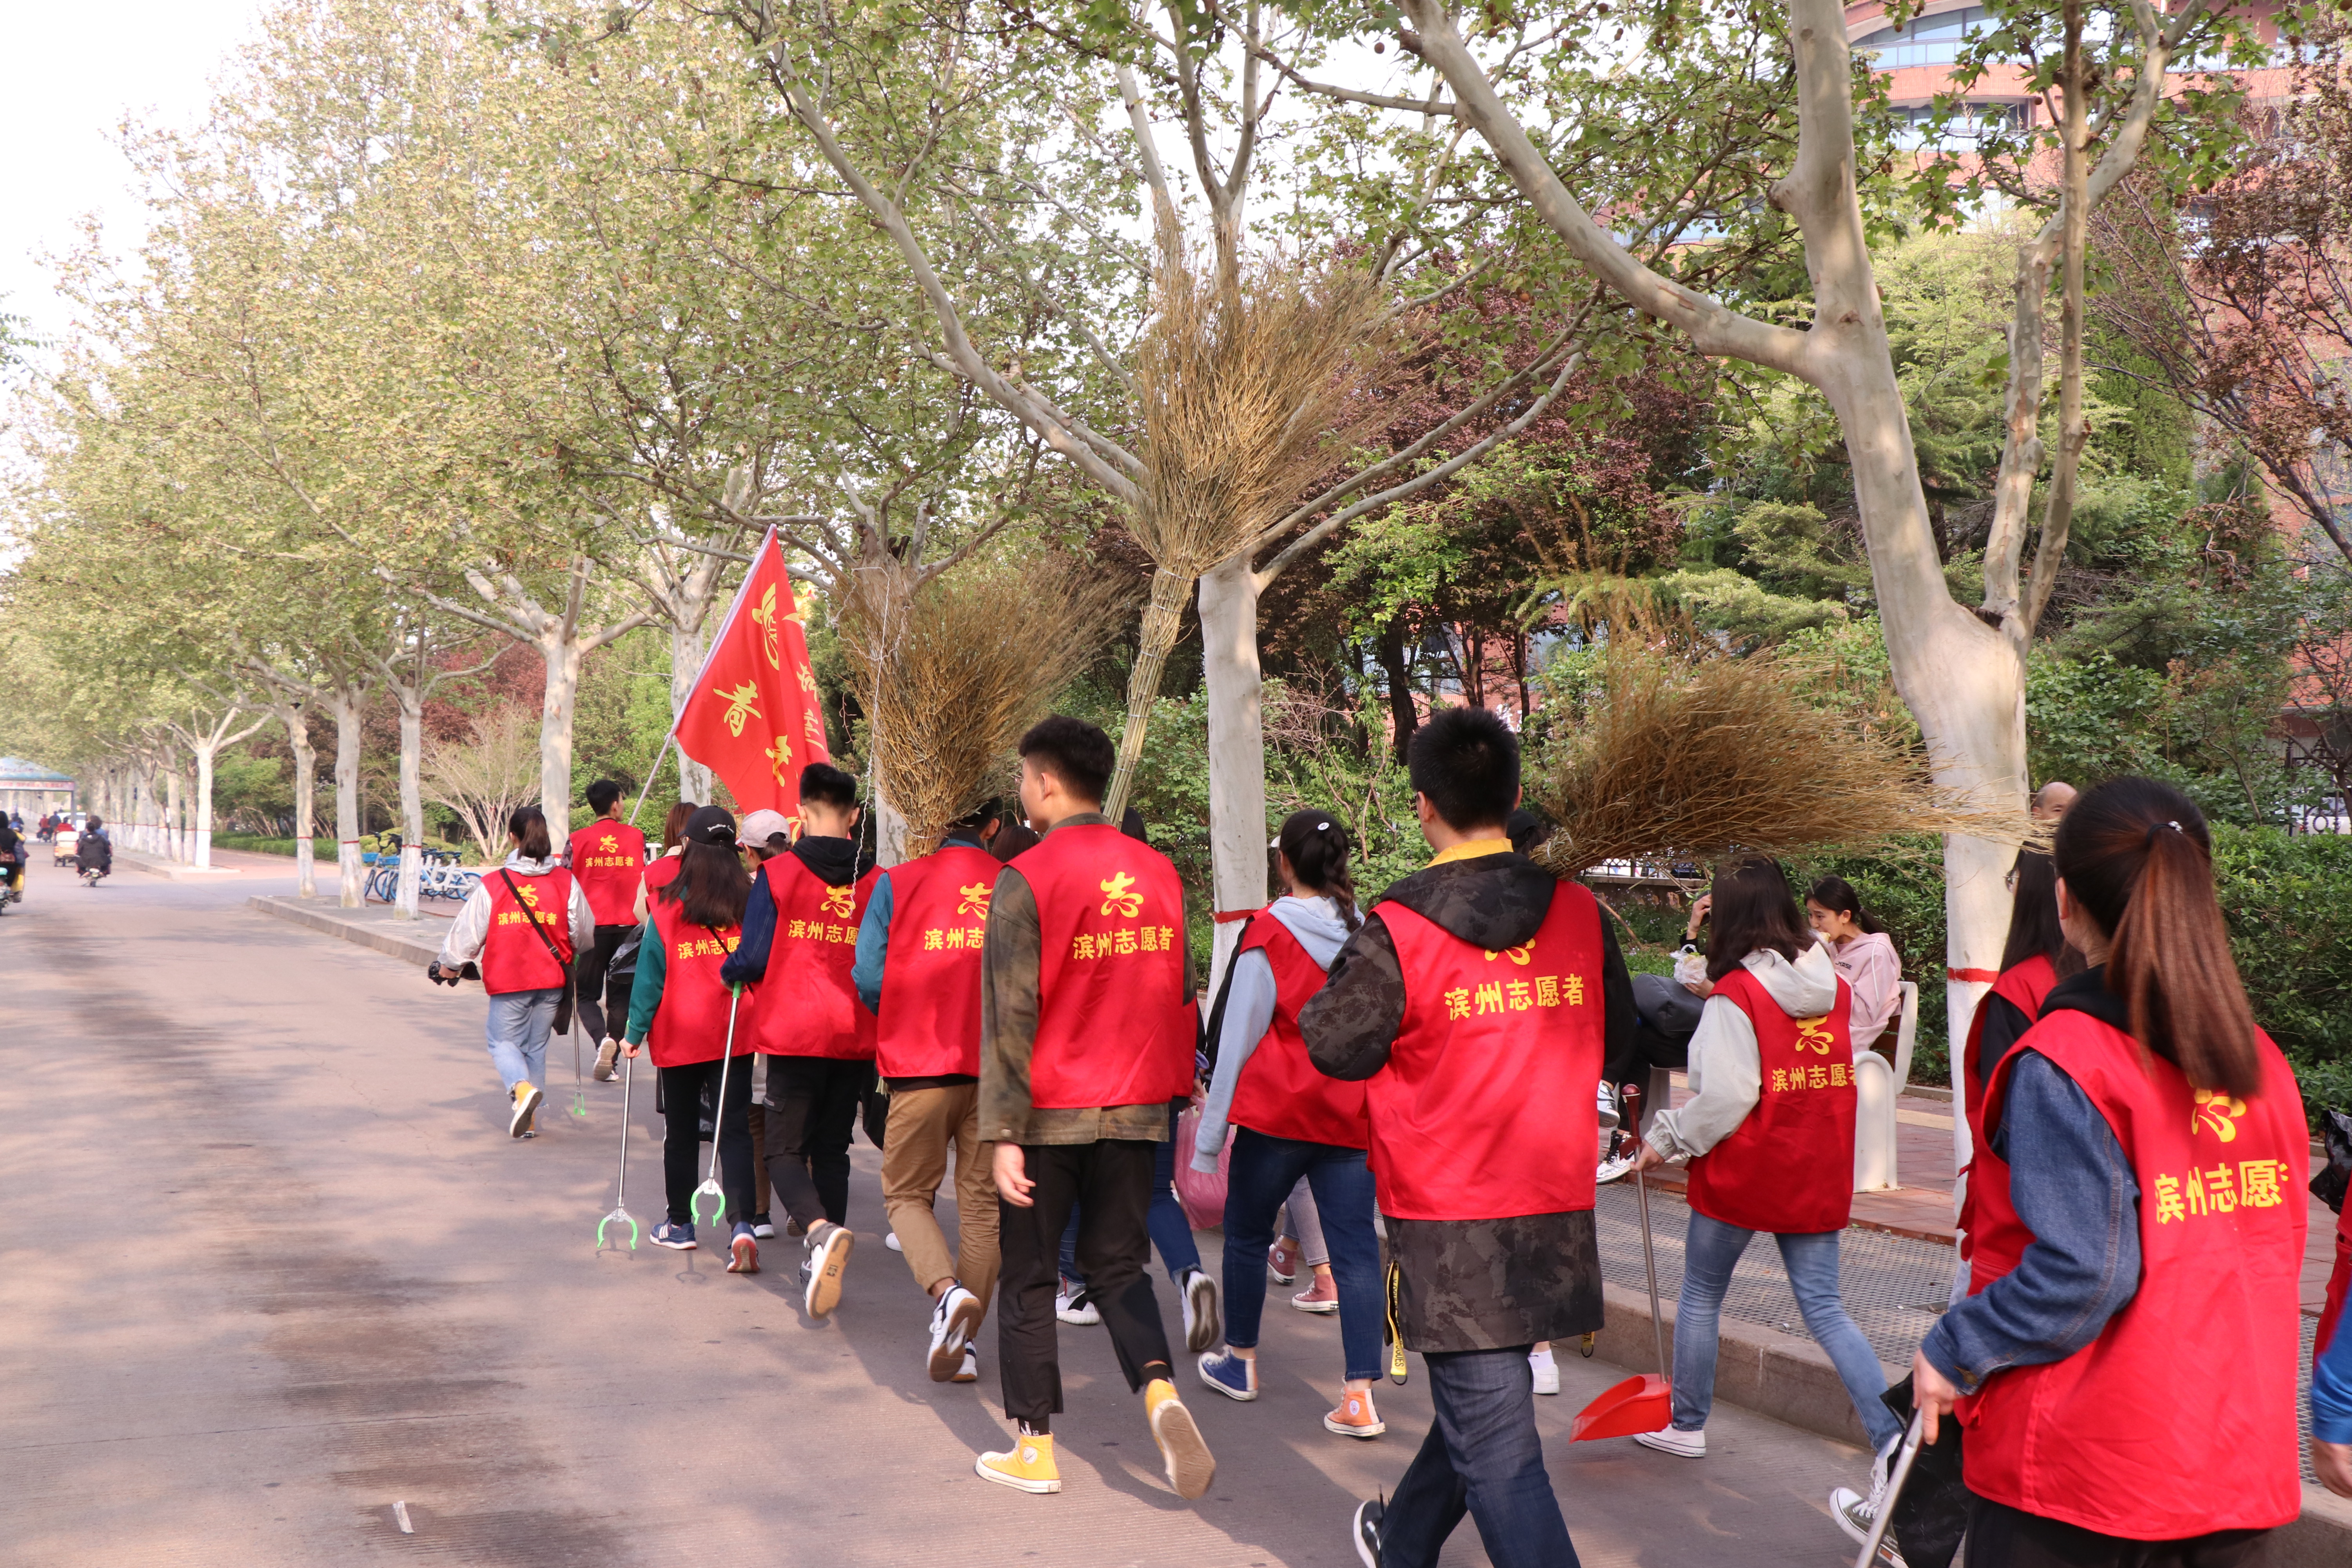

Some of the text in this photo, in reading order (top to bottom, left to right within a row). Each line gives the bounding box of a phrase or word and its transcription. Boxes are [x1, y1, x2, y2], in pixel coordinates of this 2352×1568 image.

[585, 855, 634, 867] 滨州志愿者
[1073, 925, 1174, 960] 滨州志愿者
[1444, 973, 1584, 1021] 滨州志愿者
[2154, 1159, 2289, 1225] 滨州志愿
